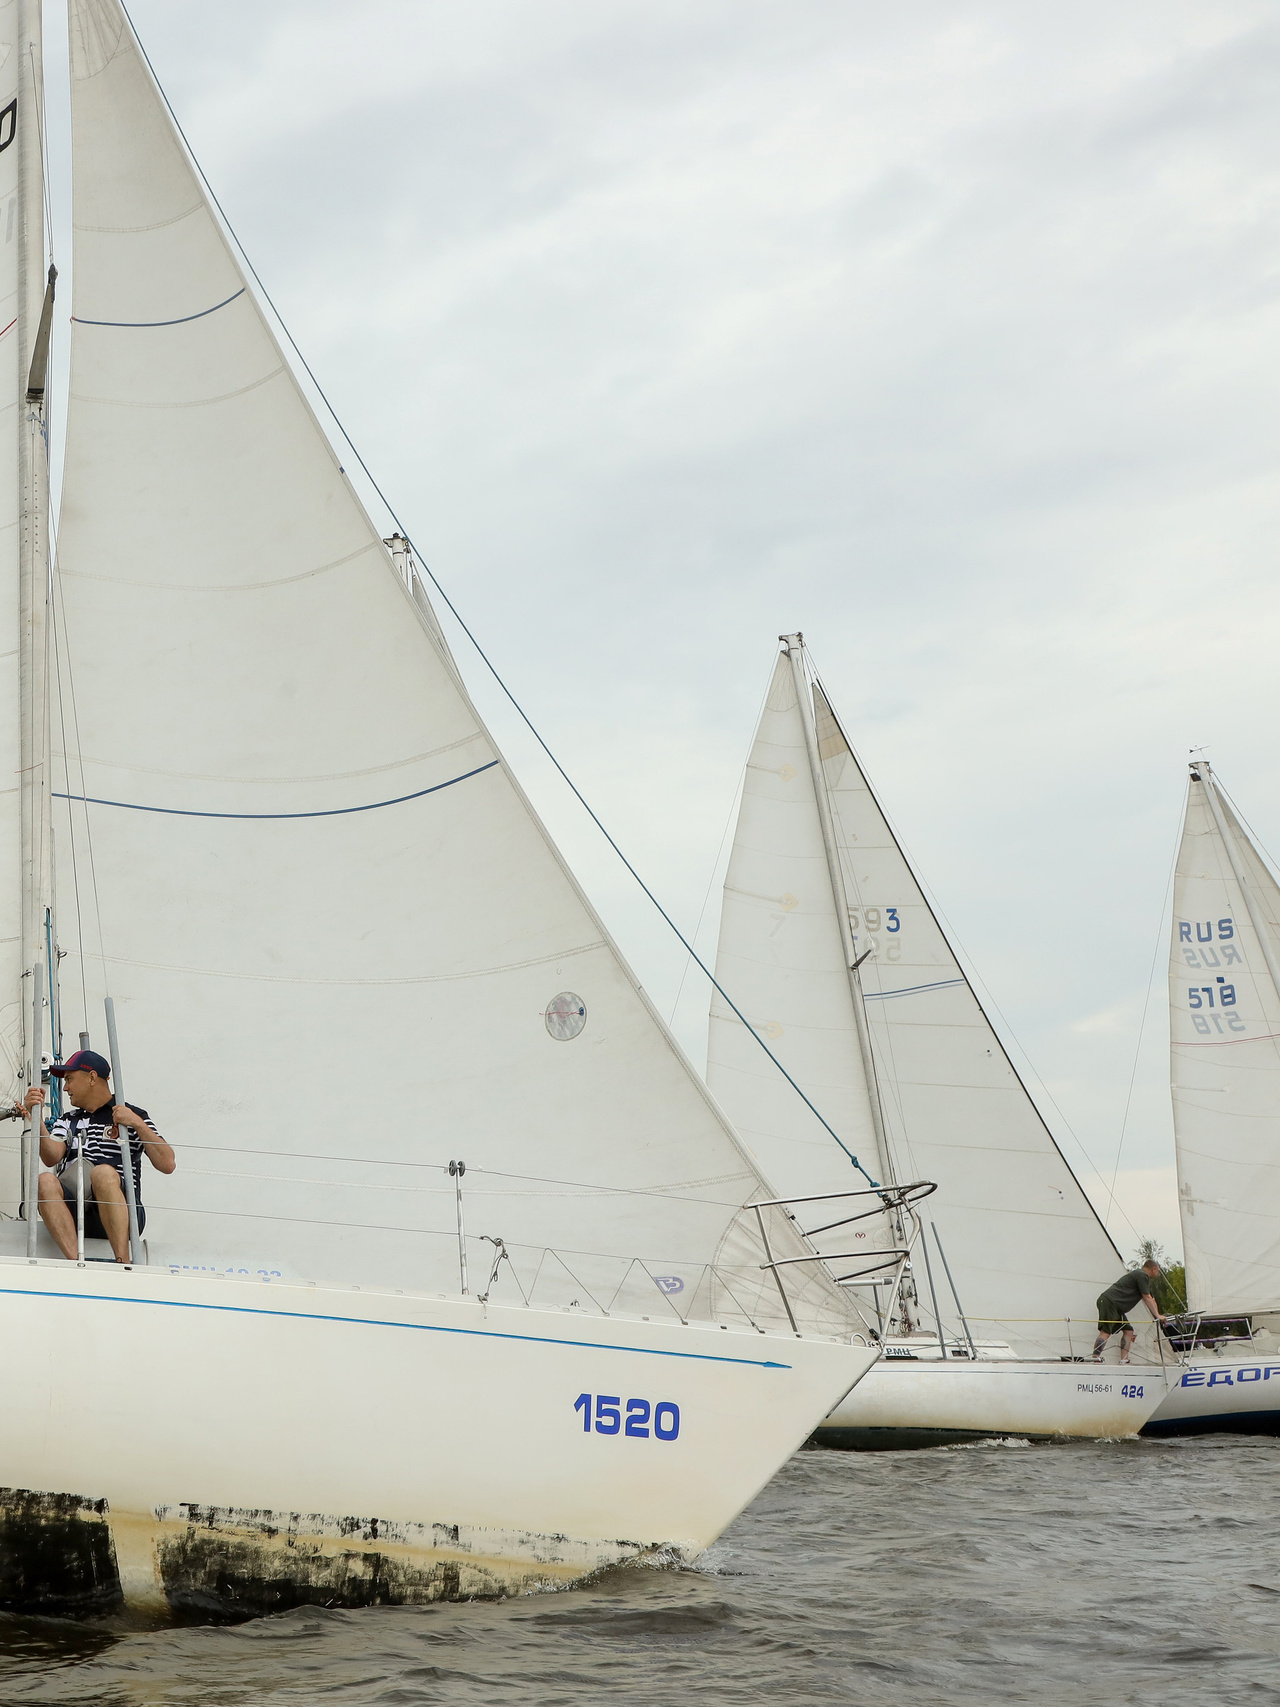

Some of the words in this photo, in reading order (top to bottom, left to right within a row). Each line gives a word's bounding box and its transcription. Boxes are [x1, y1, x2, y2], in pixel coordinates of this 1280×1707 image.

[1178, 918, 1234, 943] RUS
[1175, 1366, 1280, 1388] ЁДОР
[1077, 1383, 1094, 1394] РМЦ
[1094, 1384, 1113, 1393] 56-61
[1121, 1384, 1144, 1399] 424
[573, 1393, 681, 1442] 1520
